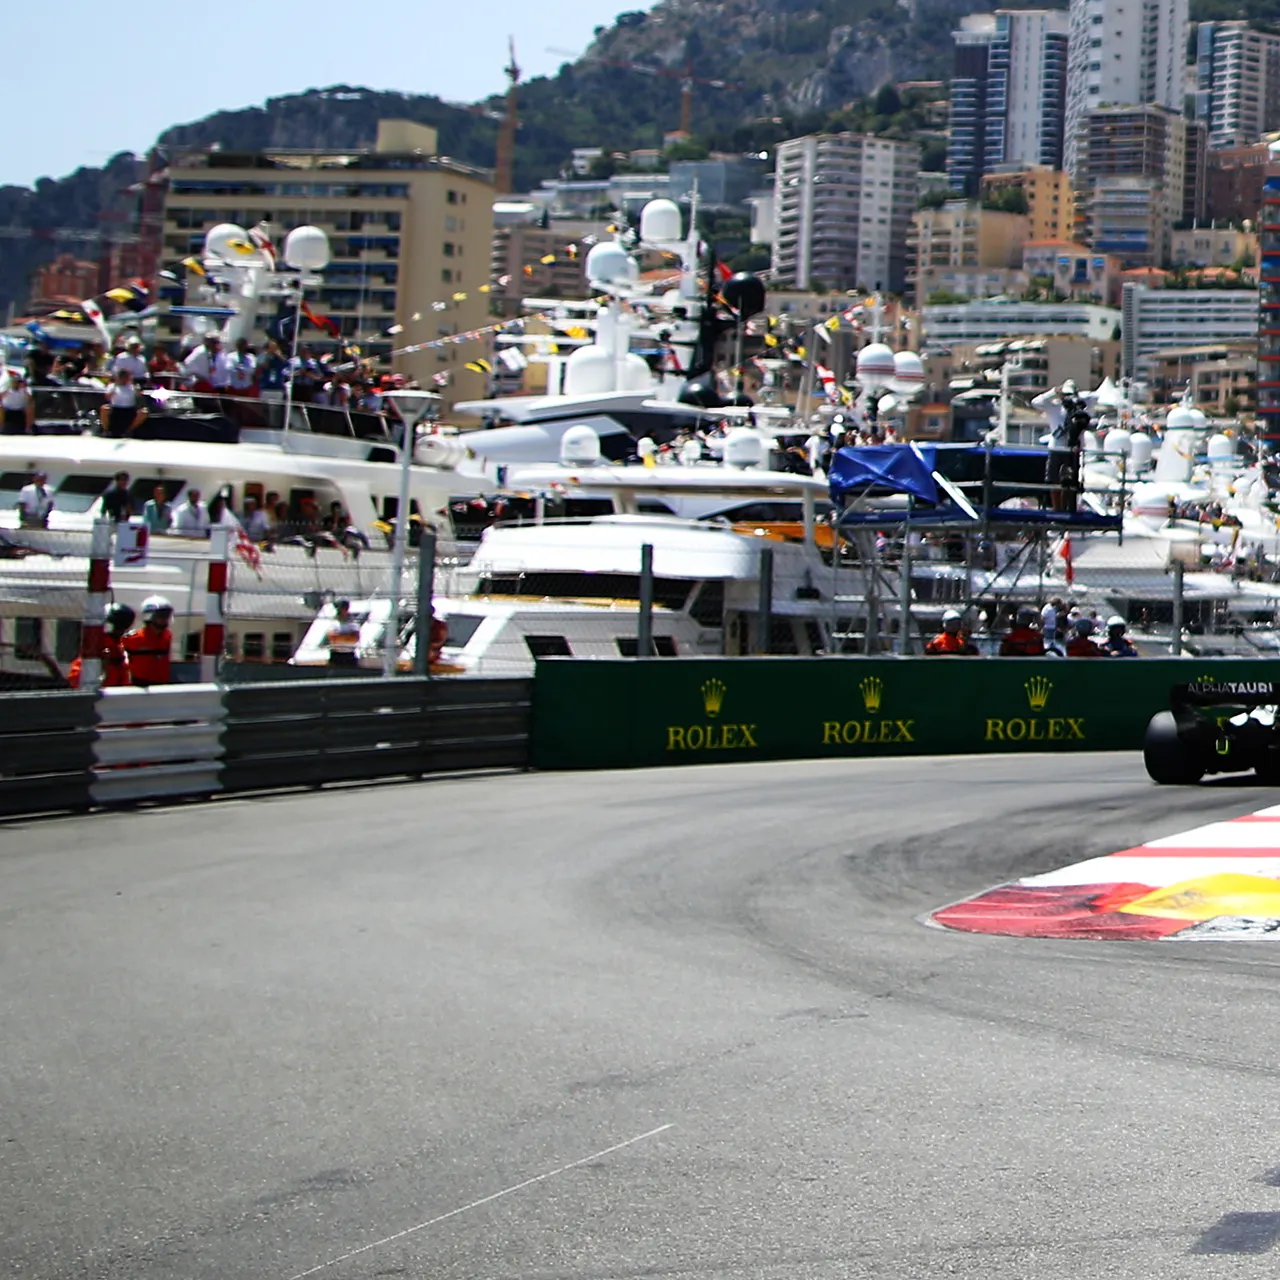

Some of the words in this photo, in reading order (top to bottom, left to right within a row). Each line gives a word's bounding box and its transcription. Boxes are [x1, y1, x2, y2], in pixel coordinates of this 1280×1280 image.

[1187, 681, 1274, 694] ALPHATAURI
[666, 723, 759, 751] ROLEX
[822, 719, 916, 745] ROLEX
[985, 717, 1086, 741] ROLEX
